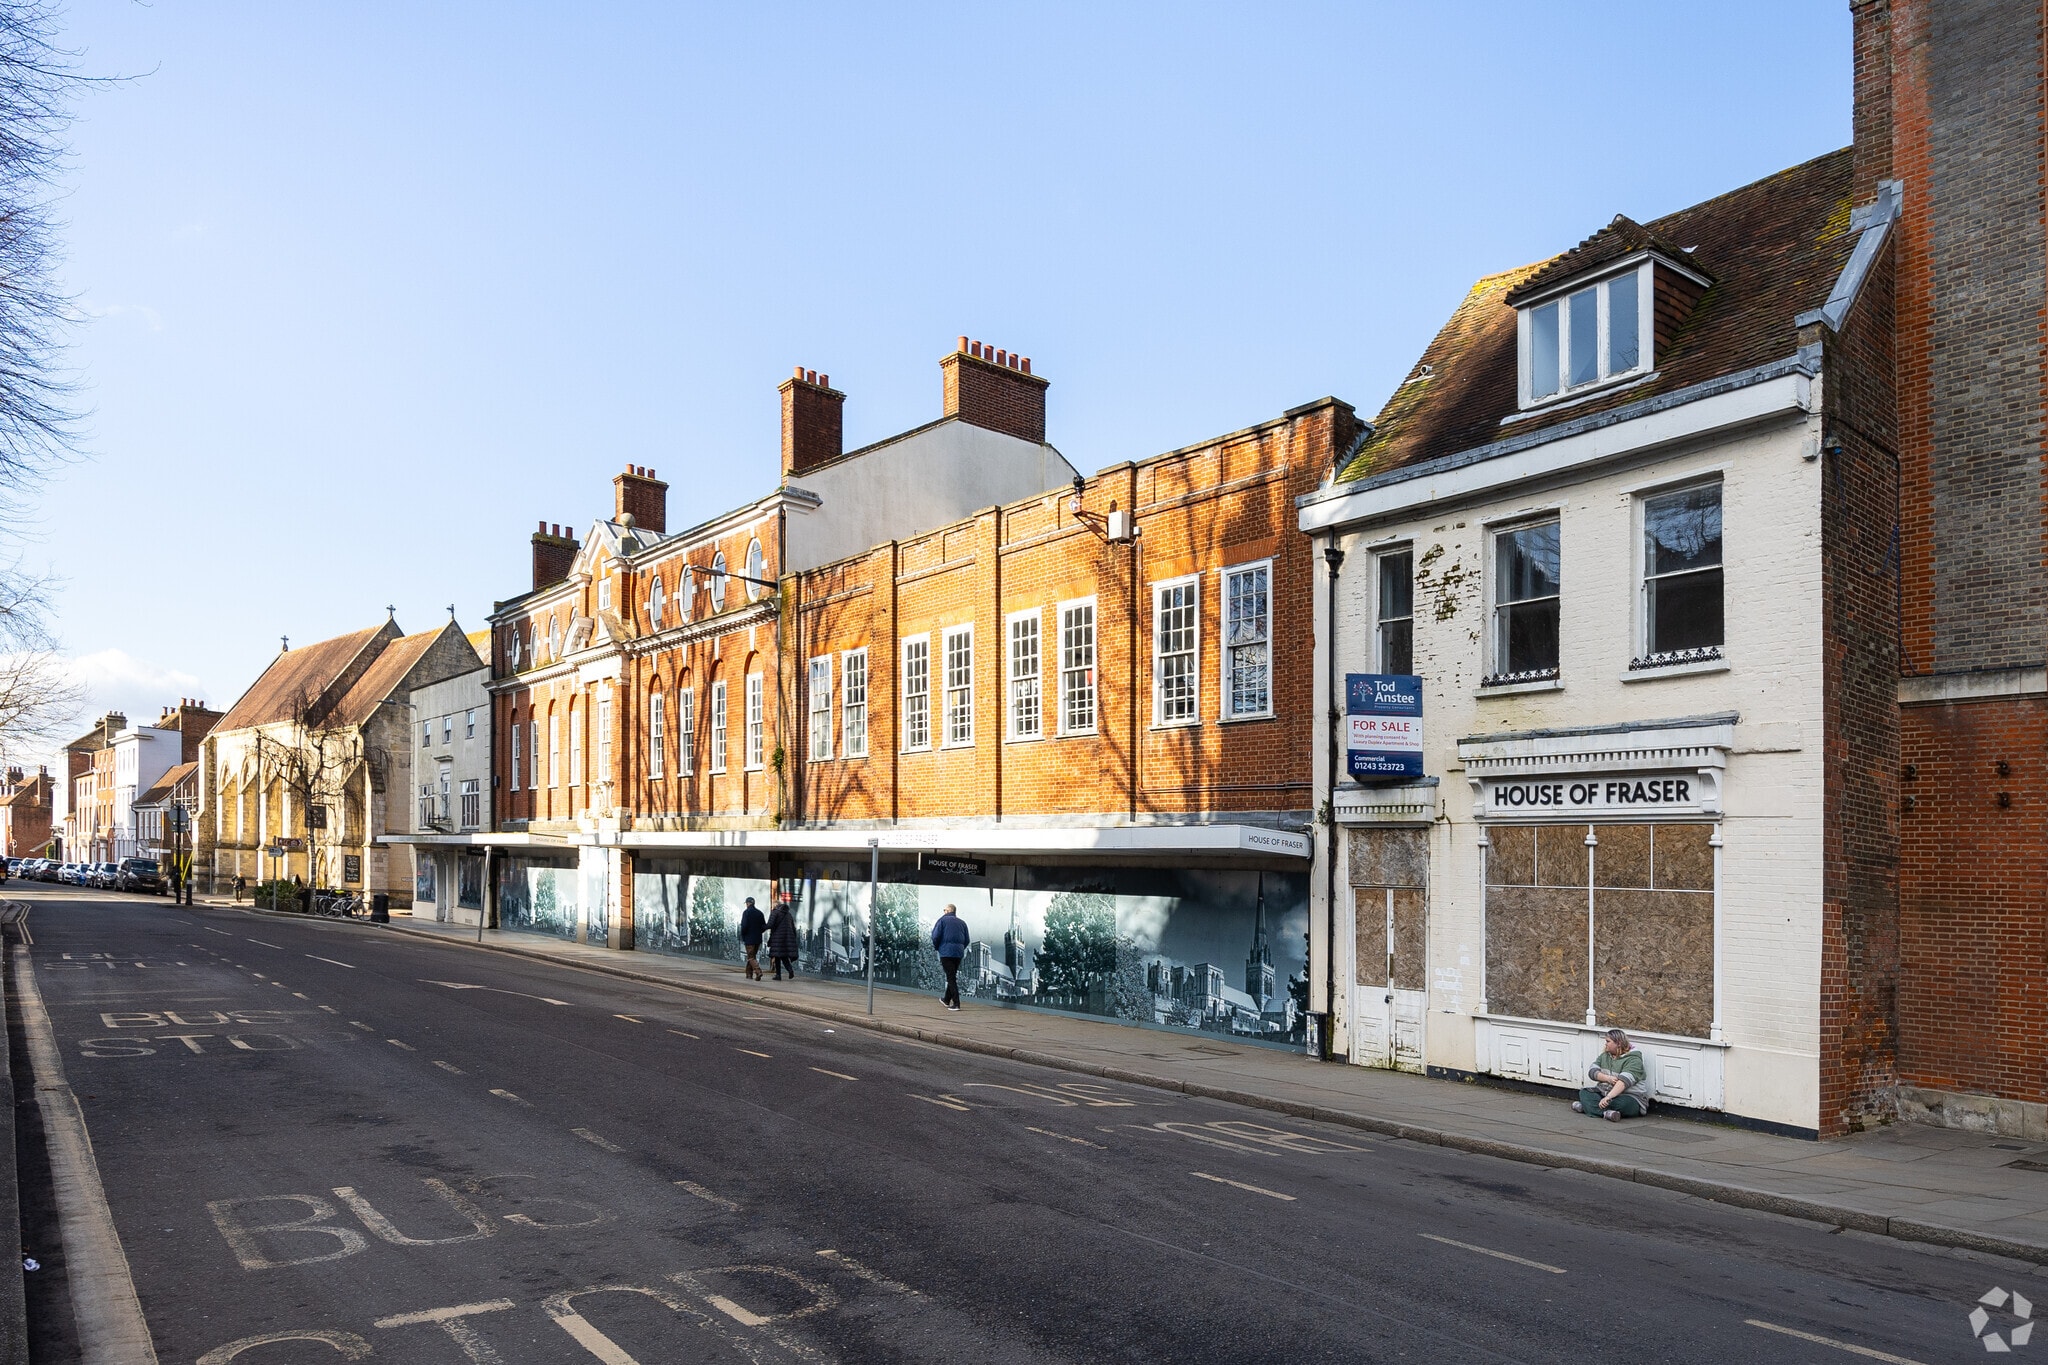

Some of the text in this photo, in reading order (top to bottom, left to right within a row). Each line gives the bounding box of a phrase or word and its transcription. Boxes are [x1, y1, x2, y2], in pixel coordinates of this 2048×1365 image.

[1374, 681, 1396, 692] Tod
[1374, 692, 1415, 703] Anstee
[1353, 720, 1410, 732] FOR SALE
[1354, 762, 1405, 771] 01243 523723
[1494, 780, 1691, 807] HOUSE OF FRASER
[1248, 835, 1304, 849] HOUSE OF FRASER
[928, 859, 948, 867] HOUSE
[958, 862, 978, 870] FRASER
[100, 1010, 294, 1029] BUS
[205, 1174, 618, 1271] BUS
